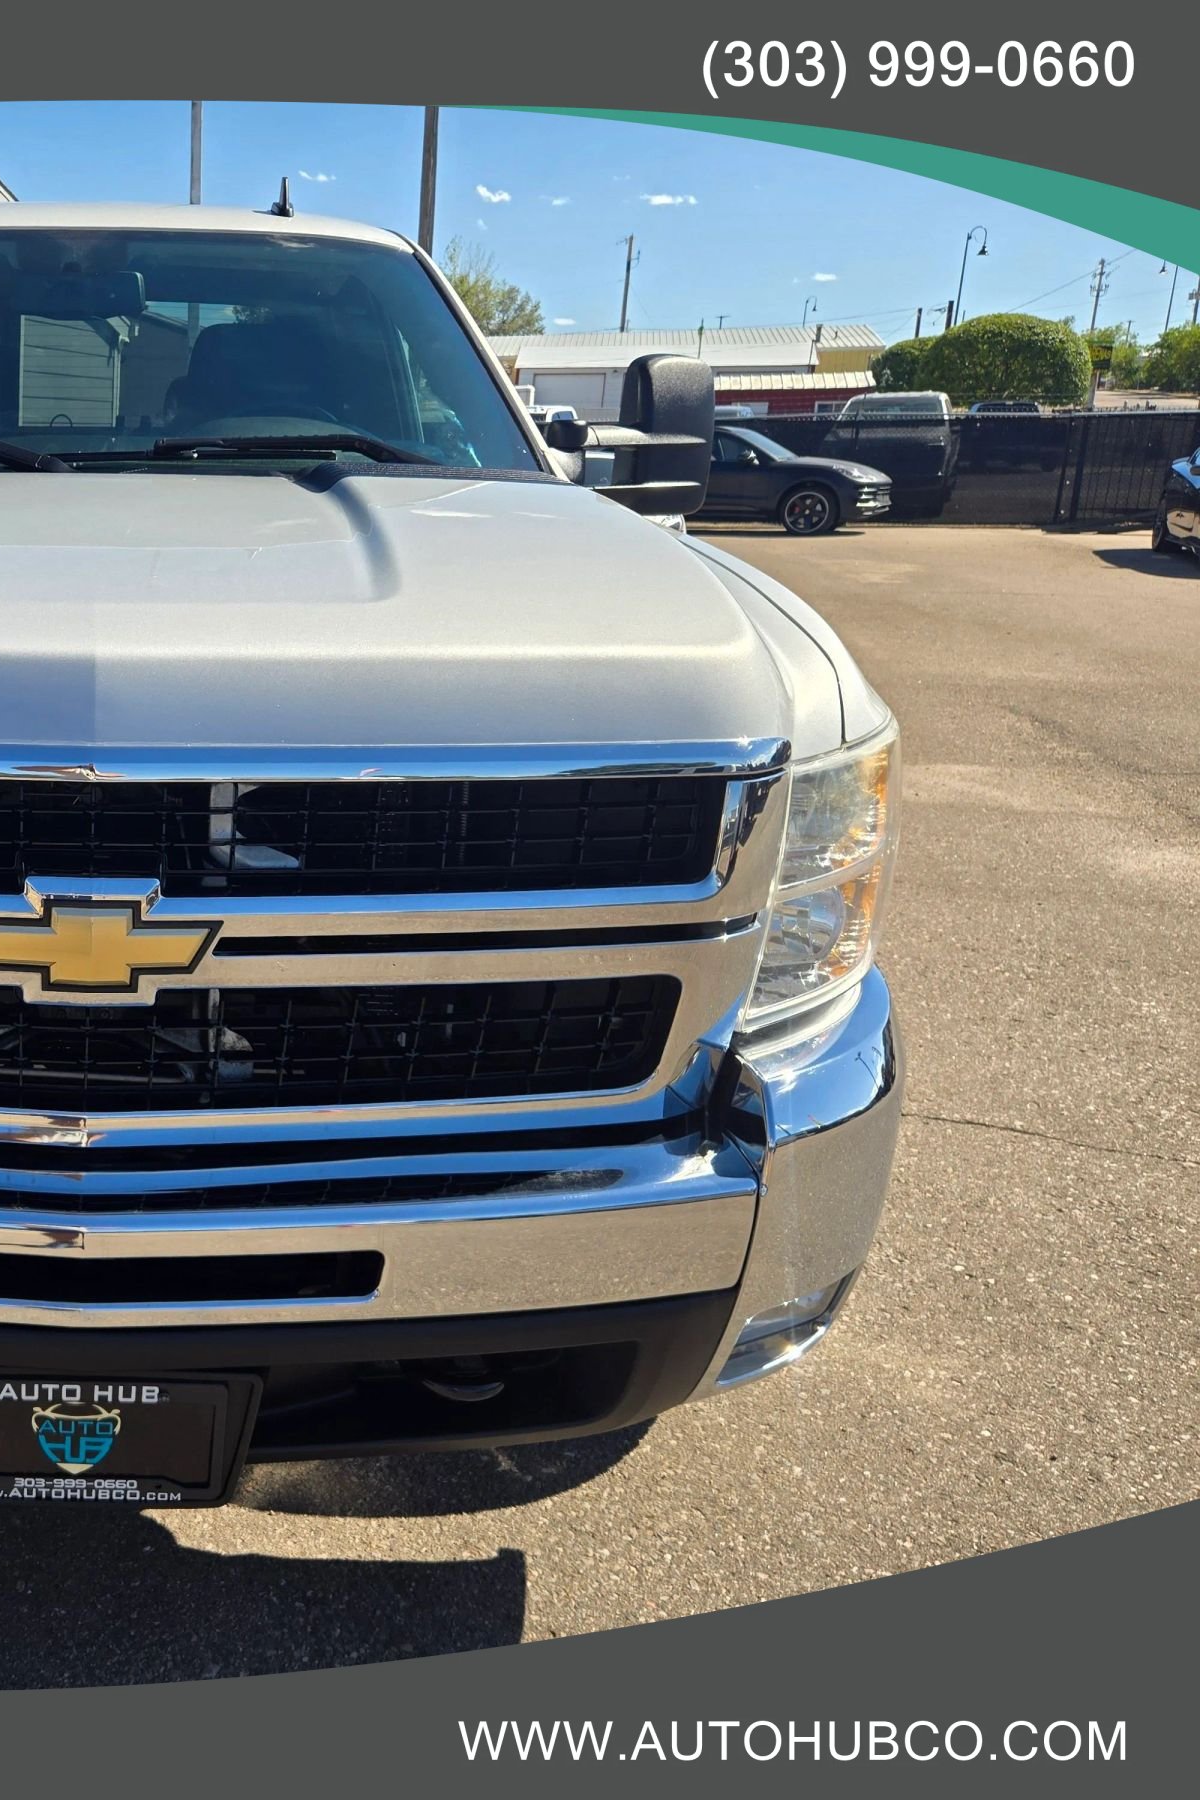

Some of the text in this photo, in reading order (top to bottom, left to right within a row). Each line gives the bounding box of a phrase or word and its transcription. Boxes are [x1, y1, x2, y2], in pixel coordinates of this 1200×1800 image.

[93, 1385, 160, 1403] HUB
[38, 1419, 113, 1435] AUTO
[38, 1434, 114, 1464] HUB
[13, 1477, 138, 1490] 303-999-0660
